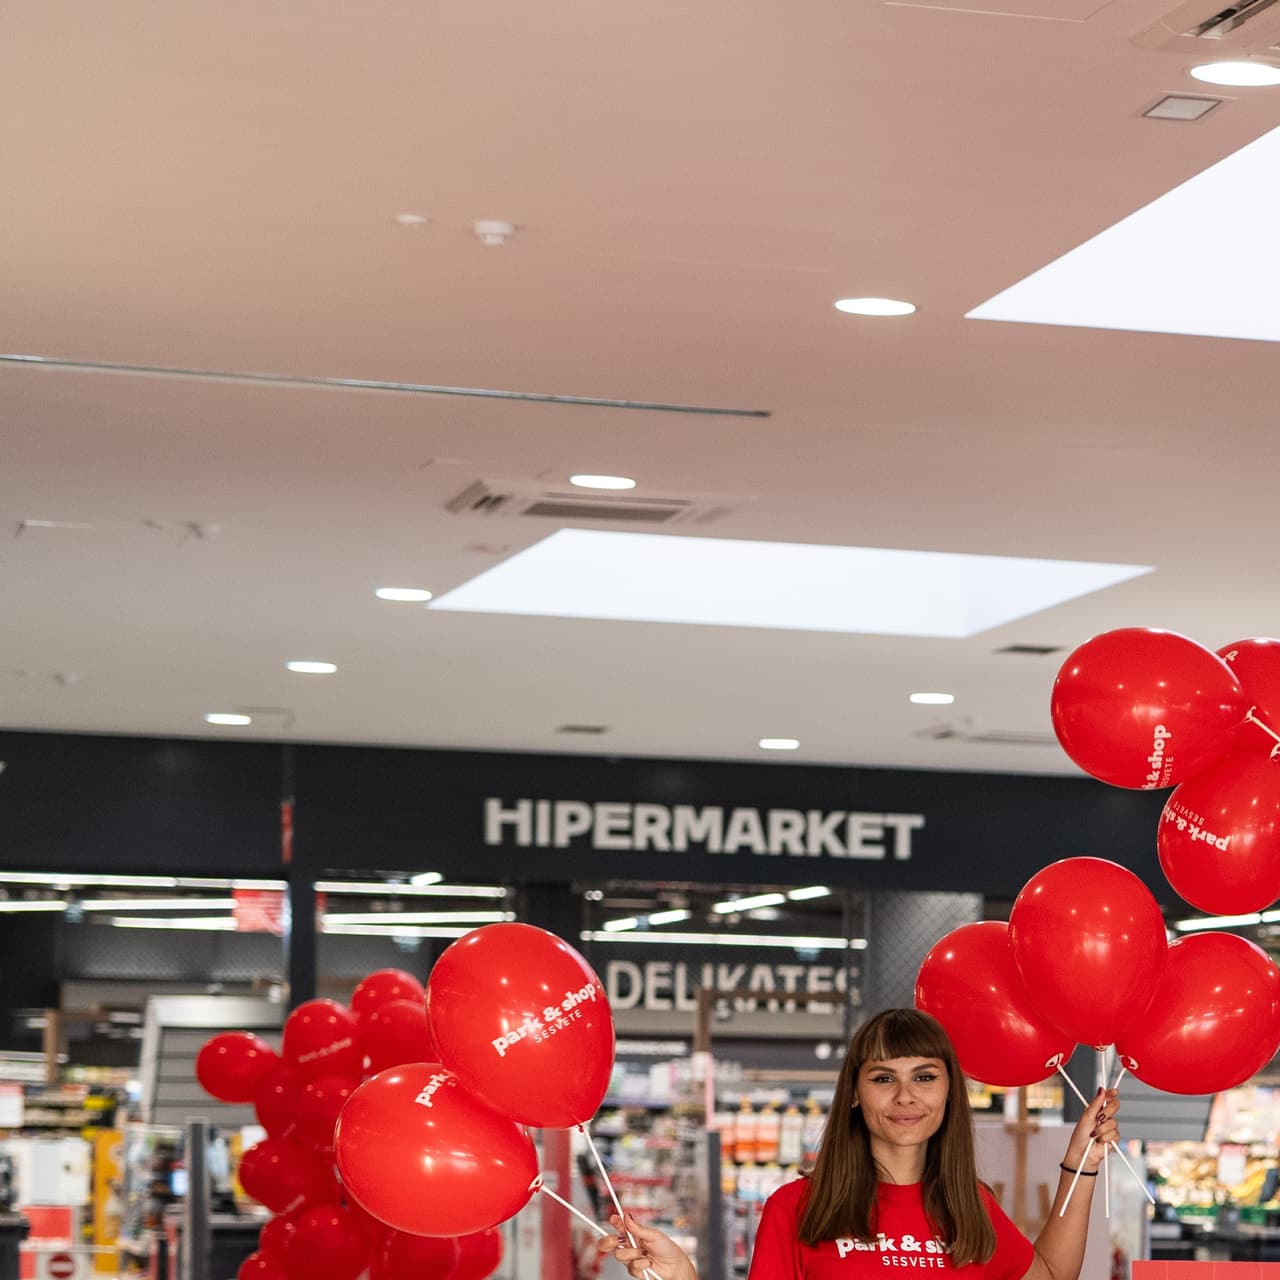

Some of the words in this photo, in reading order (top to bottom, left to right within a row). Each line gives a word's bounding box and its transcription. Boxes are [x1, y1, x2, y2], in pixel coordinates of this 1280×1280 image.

[1147, 724, 1172, 770] shop
[484, 797, 925, 860] HIPERMARKET
[1188, 823, 1231, 851] park
[491, 1017, 545, 1057] park
[543, 1006, 563, 1022] &
[561, 983, 596, 1012] shop
[534, 1009, 582, 1043] SESVETE
[414, 1073, 449, 1108] park
[835, 1233, 898, 1258] park
[900, 1234, 922, 1252] &
[882, 1256, 945, 1268] SESVETE
